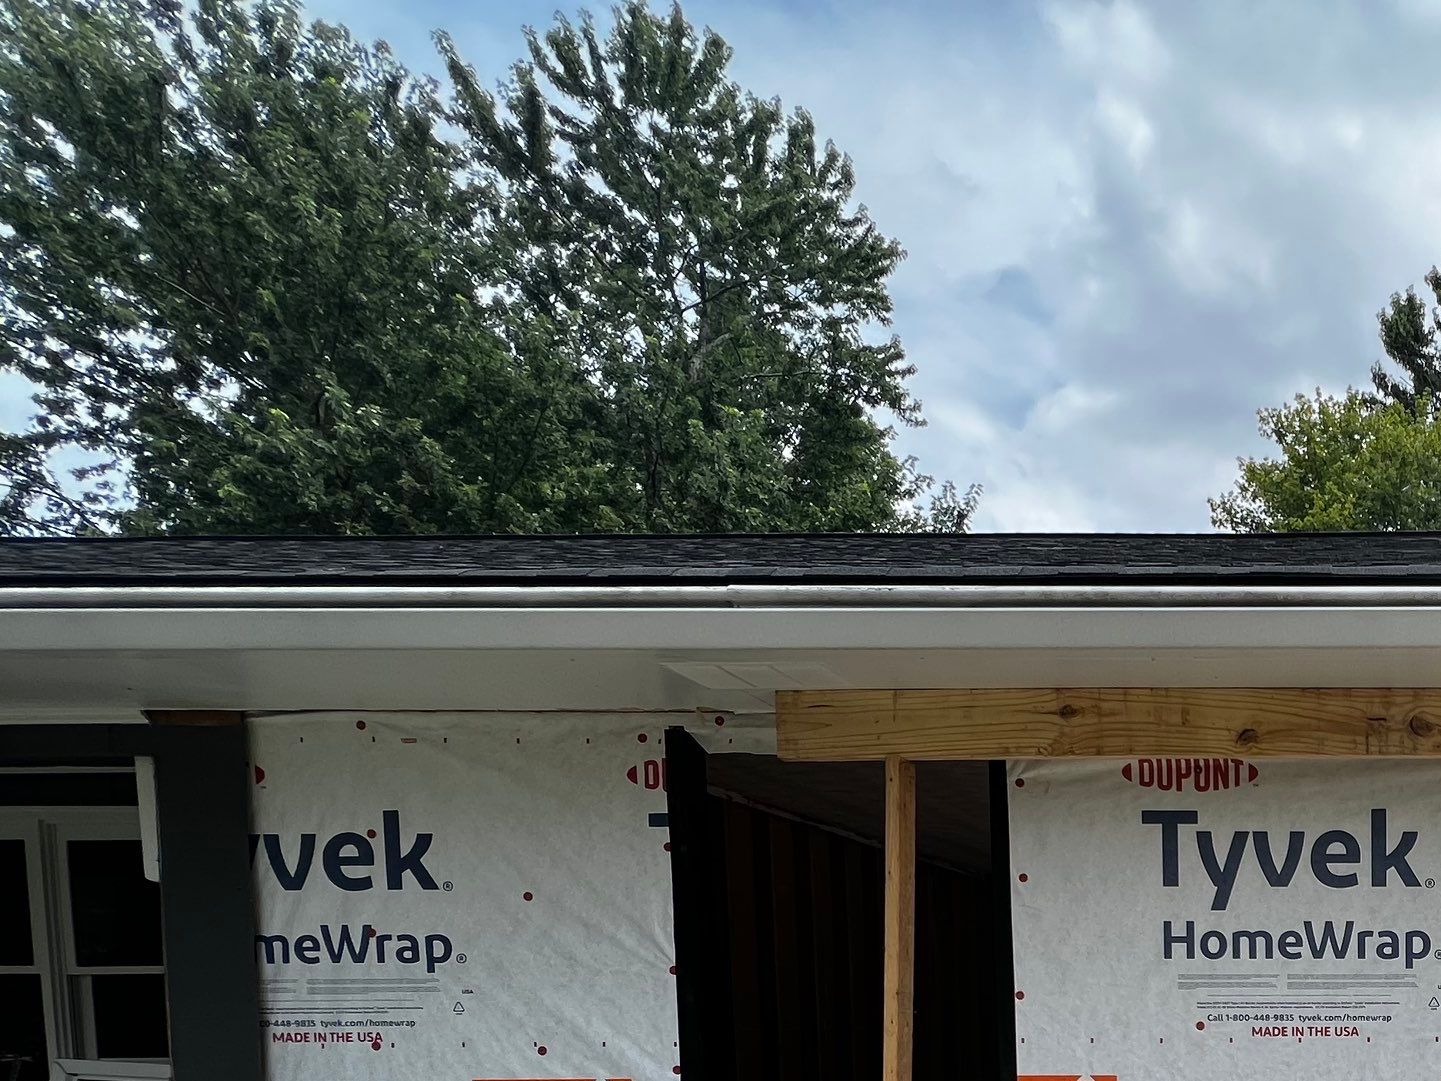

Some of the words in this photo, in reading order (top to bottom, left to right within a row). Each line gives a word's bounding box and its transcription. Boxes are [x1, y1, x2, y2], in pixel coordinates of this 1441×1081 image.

[1138, 758, 1245, 792] DUPONT
[1141, 809, 1421, 911] Tyvek
[1163, 921, 1431, 969] HomeWrap
[1207, 1013, 1223, 1022] Call
[1226, 1014, 1295, 1022] 1-800-448-9835
[1299, 1014, 1392, 1023] tyvek.com/homewrap
[320, 1019, 416, 1030] tyvek.com/homewrap
[1251, 1026, 1288, 1037] MADE
[1292, 1026, 1304, 1037] IN
[1307, 1026, 1331, 1037] THE
[1334, 1026, 1359, 1037] USA
[272, 1032, 308, 1043] MADE
[314, 1032, 327, 1042] IN
[330, 1032, 353, 1042] THE
[357, 1032, 383, 1042] USA
